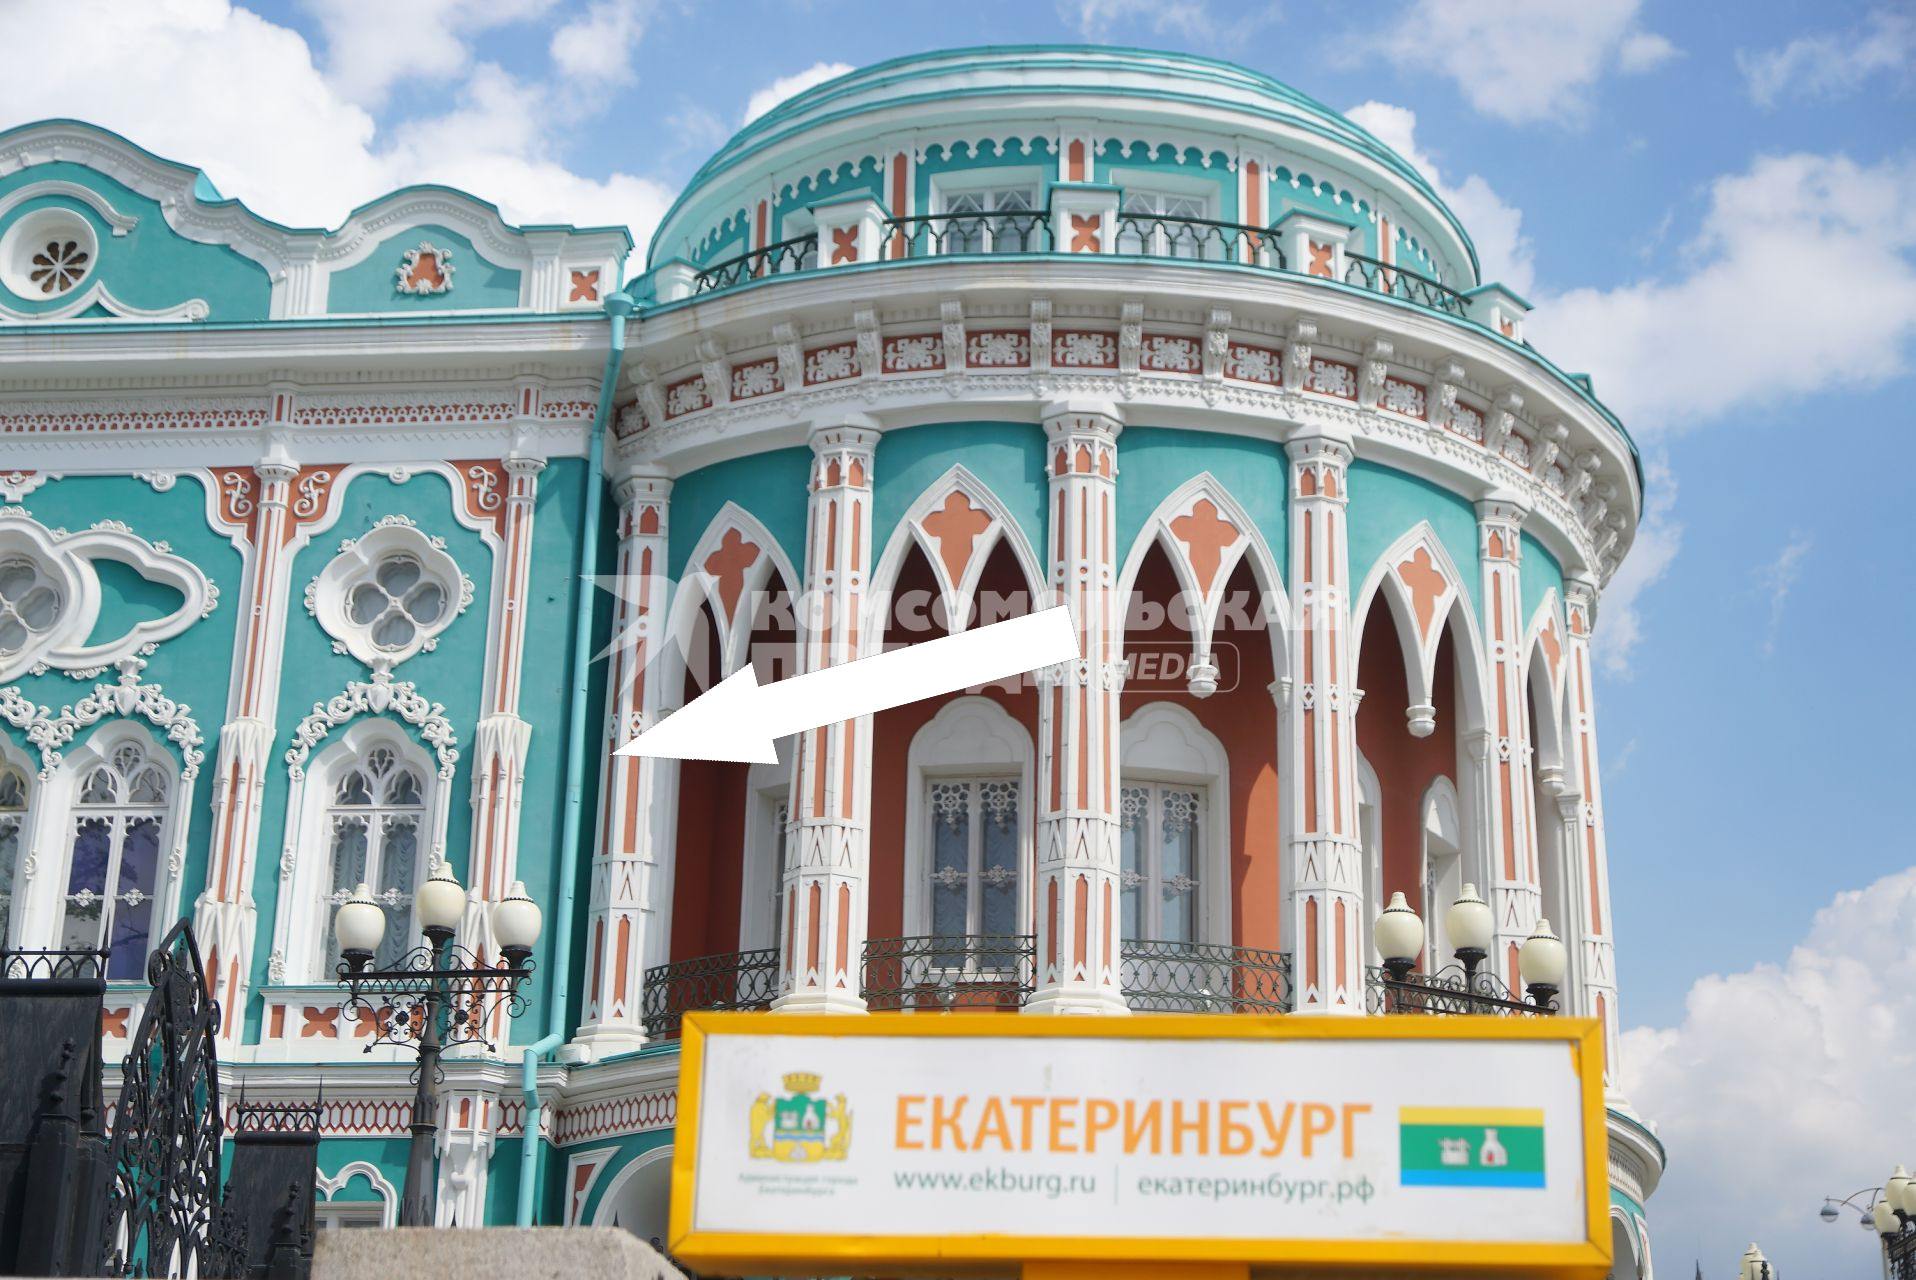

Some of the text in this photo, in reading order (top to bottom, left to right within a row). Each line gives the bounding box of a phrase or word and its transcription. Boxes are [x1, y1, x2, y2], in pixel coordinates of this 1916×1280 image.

[895, 1095, 1373, 1158] ЕКАТЕРИНБУРГ
[894, 1166, 1375, 1205] www.ekburg.ru екатеринбург.рф
